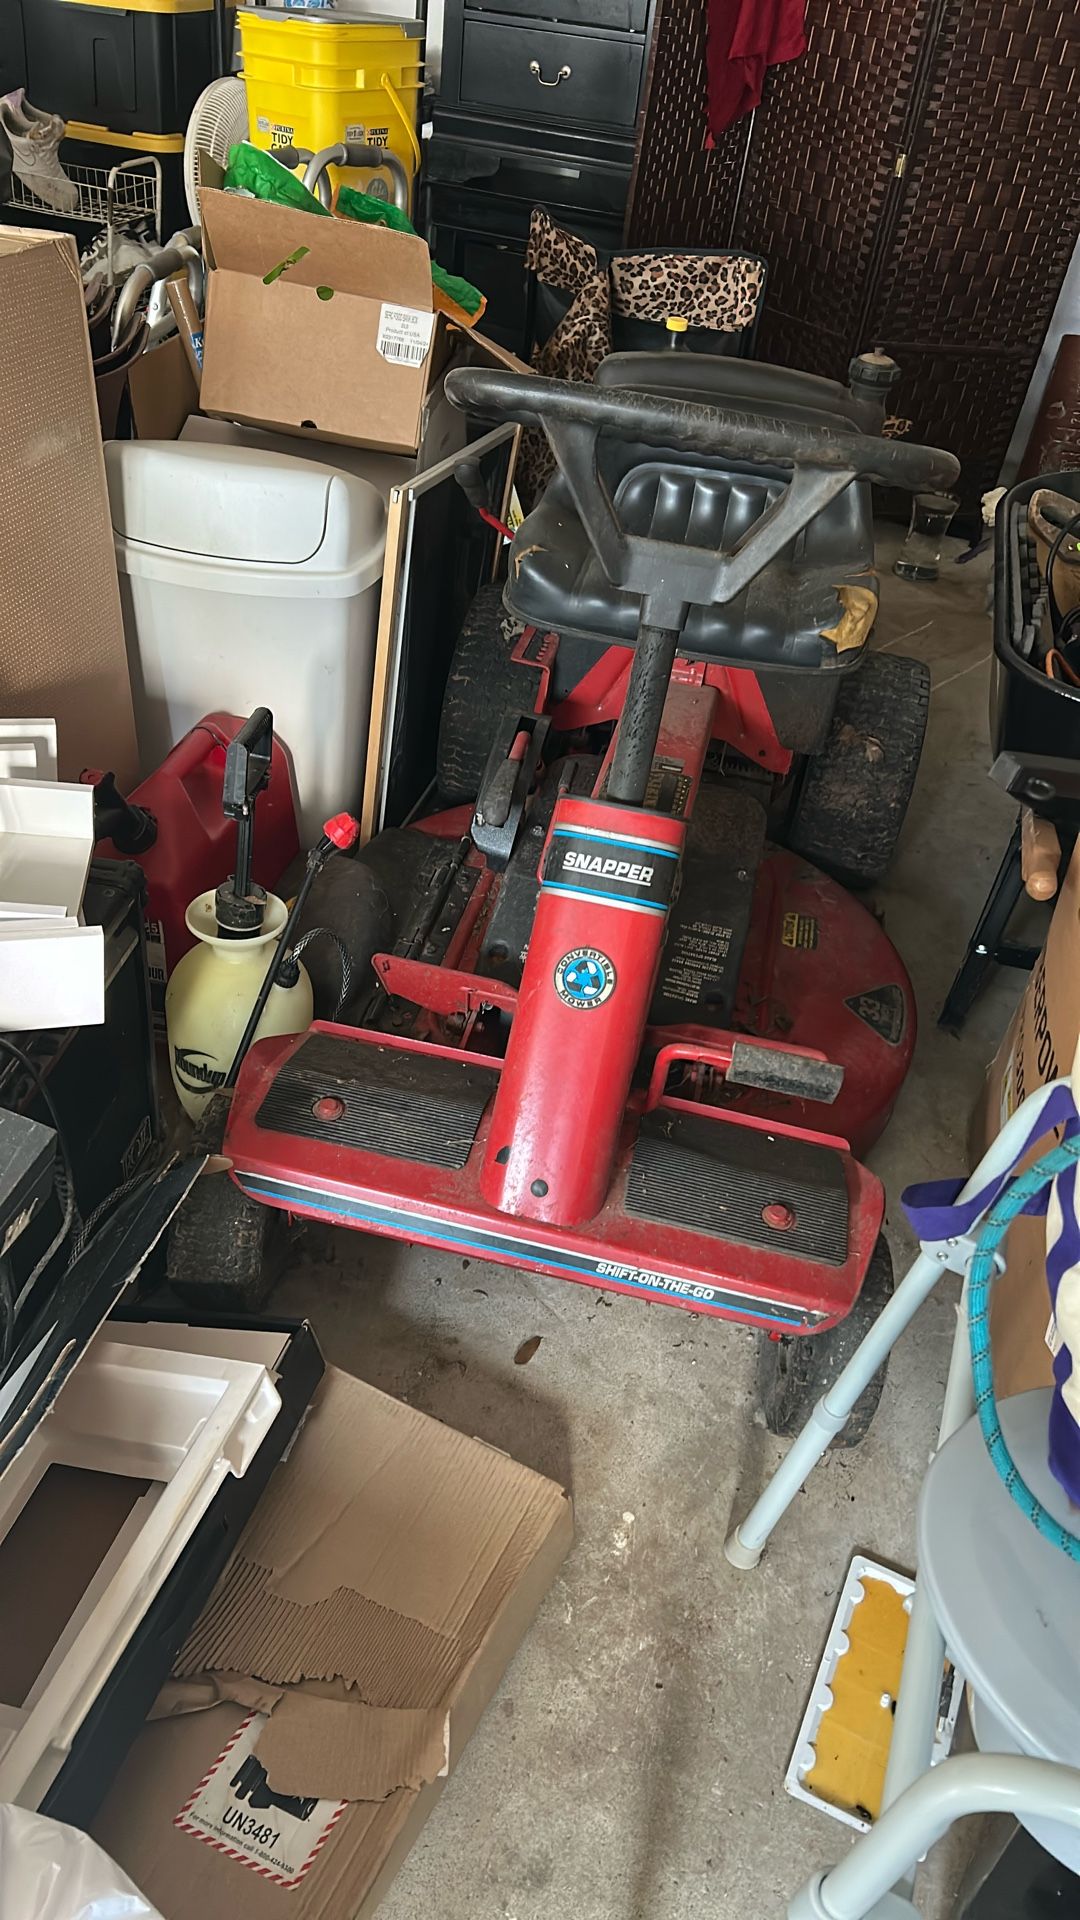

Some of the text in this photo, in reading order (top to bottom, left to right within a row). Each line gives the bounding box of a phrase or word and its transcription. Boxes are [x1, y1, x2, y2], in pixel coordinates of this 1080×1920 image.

[271, 132, 294, 145] TIDY
[367, 136, 388, 147] TIDY
[563, 851, 654, 882] SNAPPER
[557, 950, 613, 985] CONVERTIBLE
[560, 989, 602, 1007] MOWER
[596, 1262, 715, 1300] SHIFT-ON-THE-GO
[189, 1811, 199, 1821] For
[199, 1818, 213, 1830] more
[213, 1825, 243, 1846] information
[243, 1843, 255, 1852] call
[222, 1806, 281, 1849] UN3481
